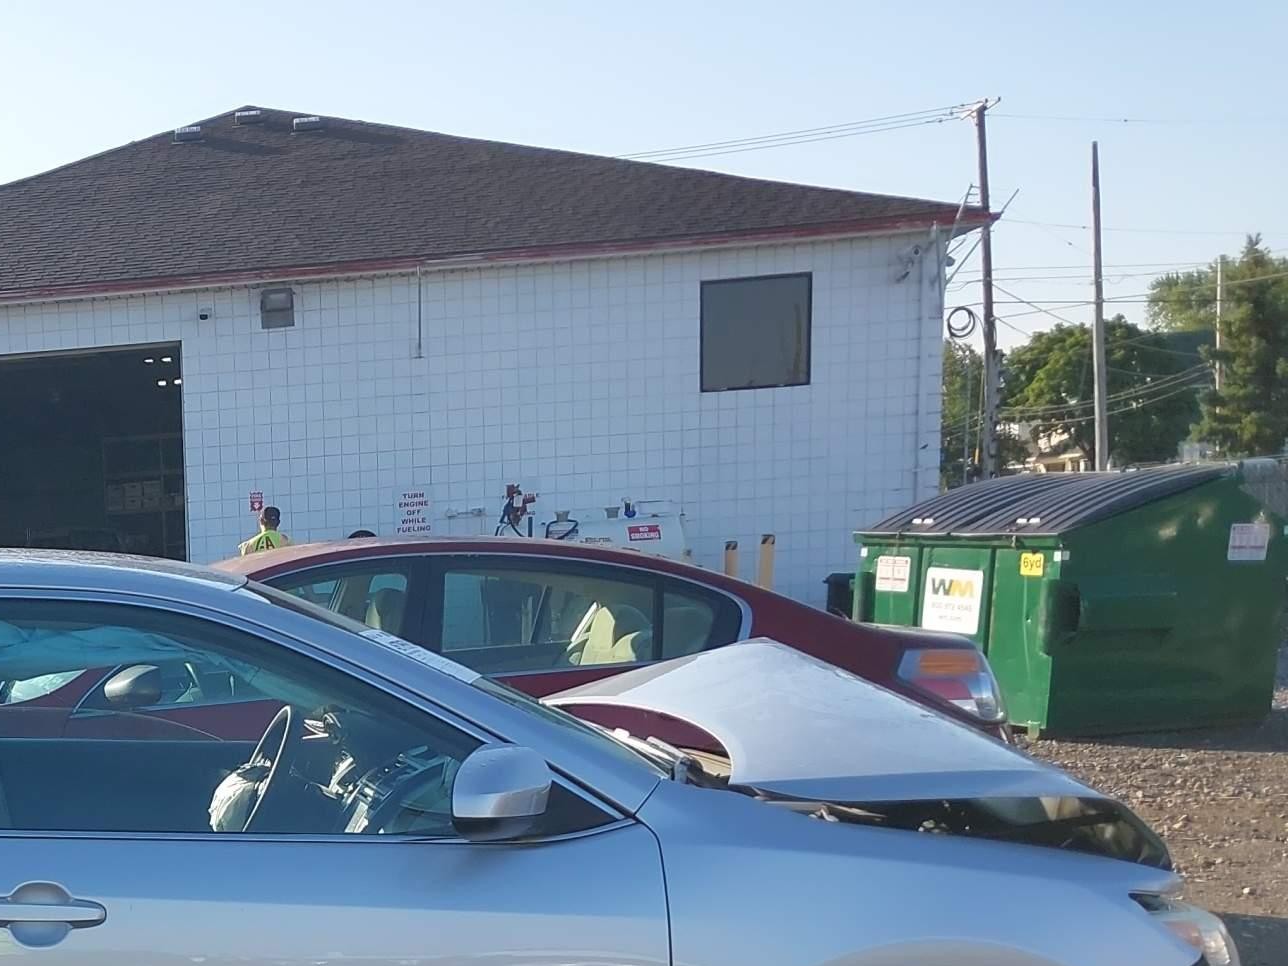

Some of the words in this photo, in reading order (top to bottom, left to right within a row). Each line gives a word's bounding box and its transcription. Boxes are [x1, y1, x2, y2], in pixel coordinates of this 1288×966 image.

[398, 500, 429, 508] ENGINE
[401, 517, 426, 525] WHILE
[397, 525, 431, 534] FUELING
[1023, 556, 1042, 571] 6yd
[931, 577, 974, 598] WM
